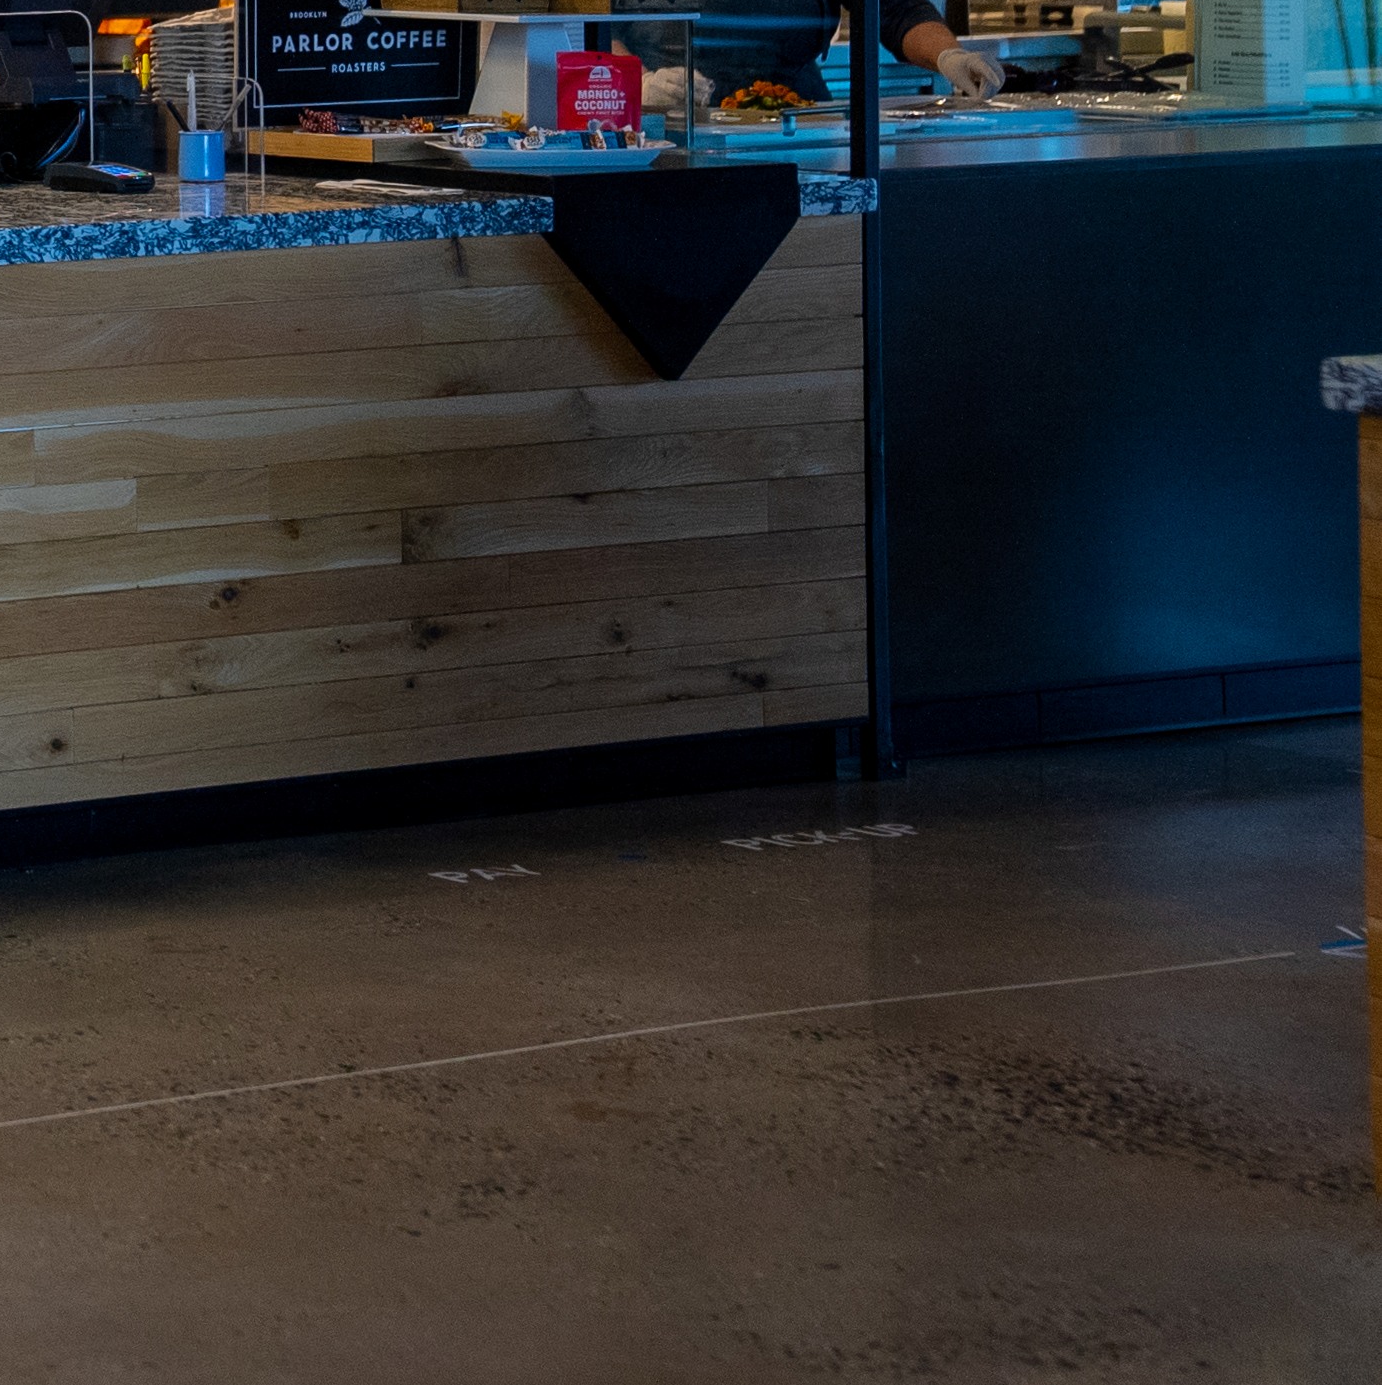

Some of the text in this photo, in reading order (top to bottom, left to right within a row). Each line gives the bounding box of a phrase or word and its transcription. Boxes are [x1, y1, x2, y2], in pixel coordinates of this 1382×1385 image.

[289, 11, 328, 19] BROOKLYN
[272, 29, 447, 53] PARLOR COFFEE
[331, 61, 386, 73] ROASTERS
[577, 89, 618, 100] MANGO
[574, 99, 627, 110] COCONUT
[721, 821, 920, 852] PICK-UP
[427, 863, 541, 884] PAY
